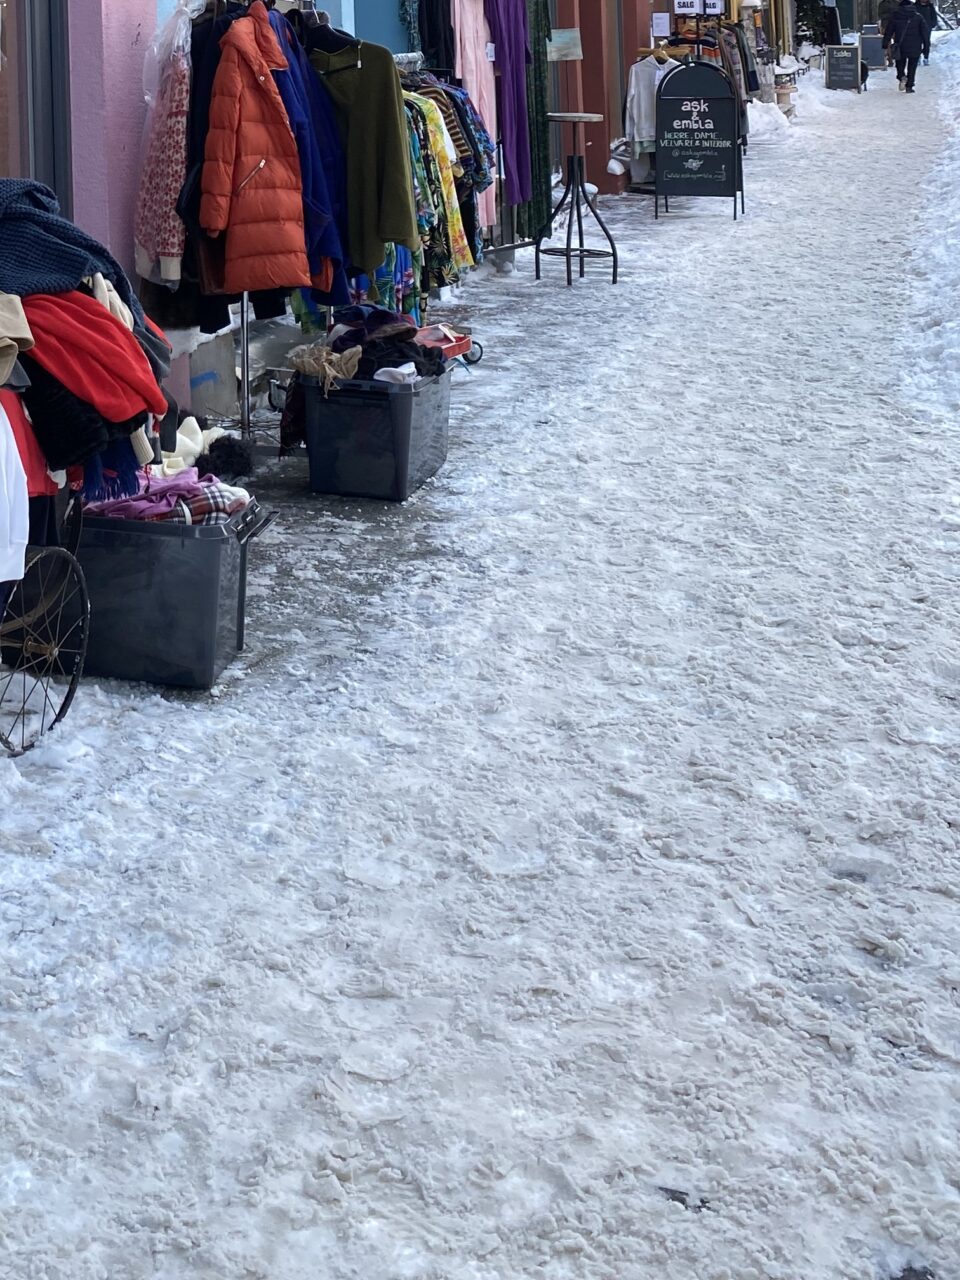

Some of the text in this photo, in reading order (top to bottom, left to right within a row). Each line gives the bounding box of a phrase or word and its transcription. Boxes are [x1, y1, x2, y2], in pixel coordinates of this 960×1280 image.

[677, 1, 695, 9] SALG
[681, 99, 709, 112] ask
[691, 111, 700, 120] &
[673, 119, 714, 129] embla
